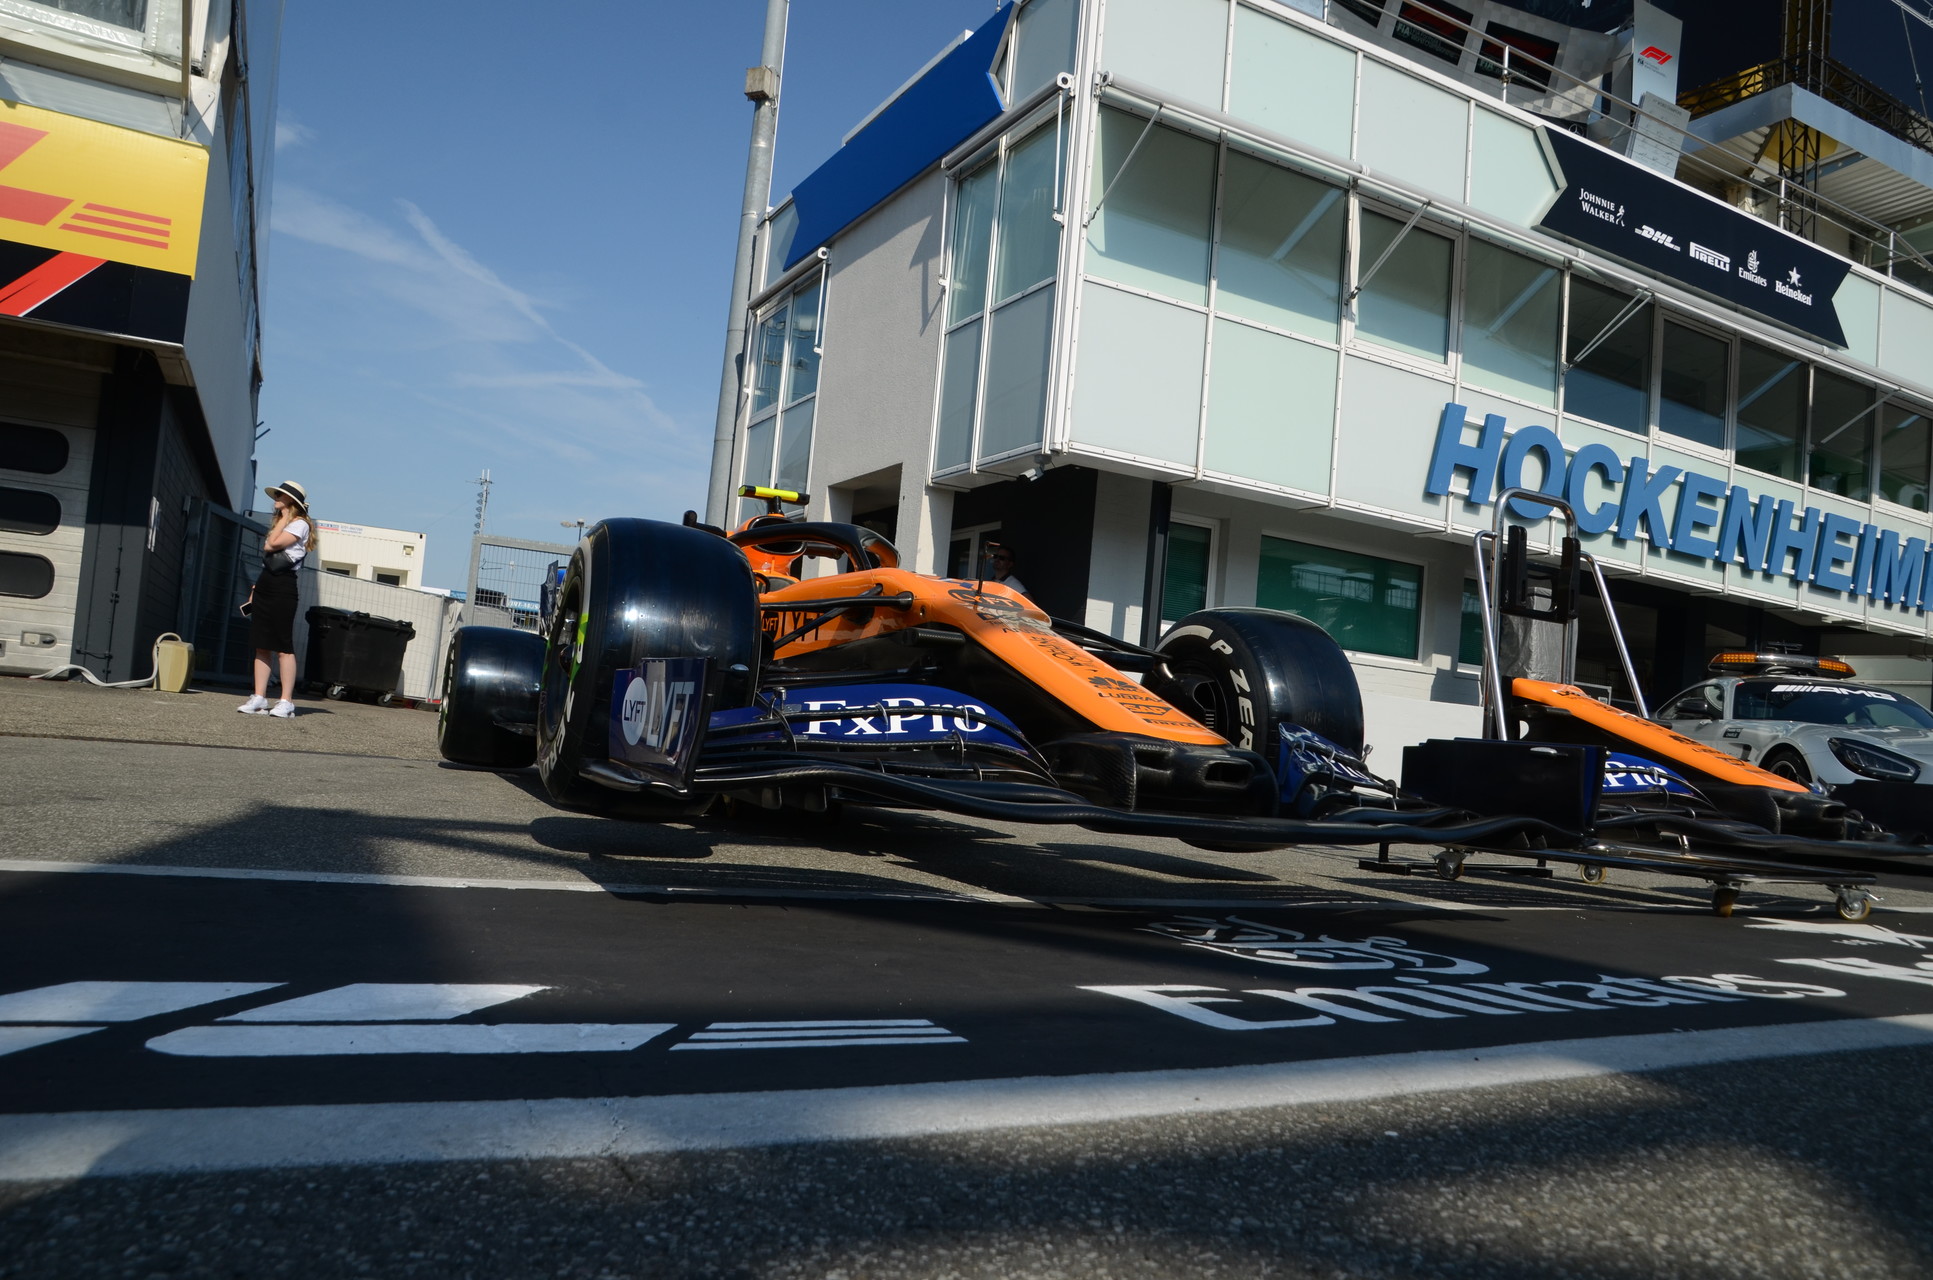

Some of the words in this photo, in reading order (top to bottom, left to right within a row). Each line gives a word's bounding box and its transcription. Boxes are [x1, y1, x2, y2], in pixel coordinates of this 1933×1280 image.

[1578, 188, 1616, 212] JOHNNIE
[1581, 201, 1616, 224] WALKER
[1639, 225, 1677, 250] DHL
[1689, 241, 1731, 272] PIRELLI
[1738, 267, 1768, 287] Emirates
[1775, 280, 1812, 306] Heineken
[1427, 402, 1933, 612] HOCKENHEIM
[762, 617, 779, 632] LYFT
[1209, 639, 1234, 655] P
[1229, 668, 1255, 751] ZER
[1810, 685, 1898, 702] AMG
[623, 699, 646, 723] LYFT
[645, 681, 695, 752] LYFT
[802, 697, 987, 735] FxPro
[1122, 703, 1167, 715] SAP
[1077, 974, 1847, 1031] Emirates
